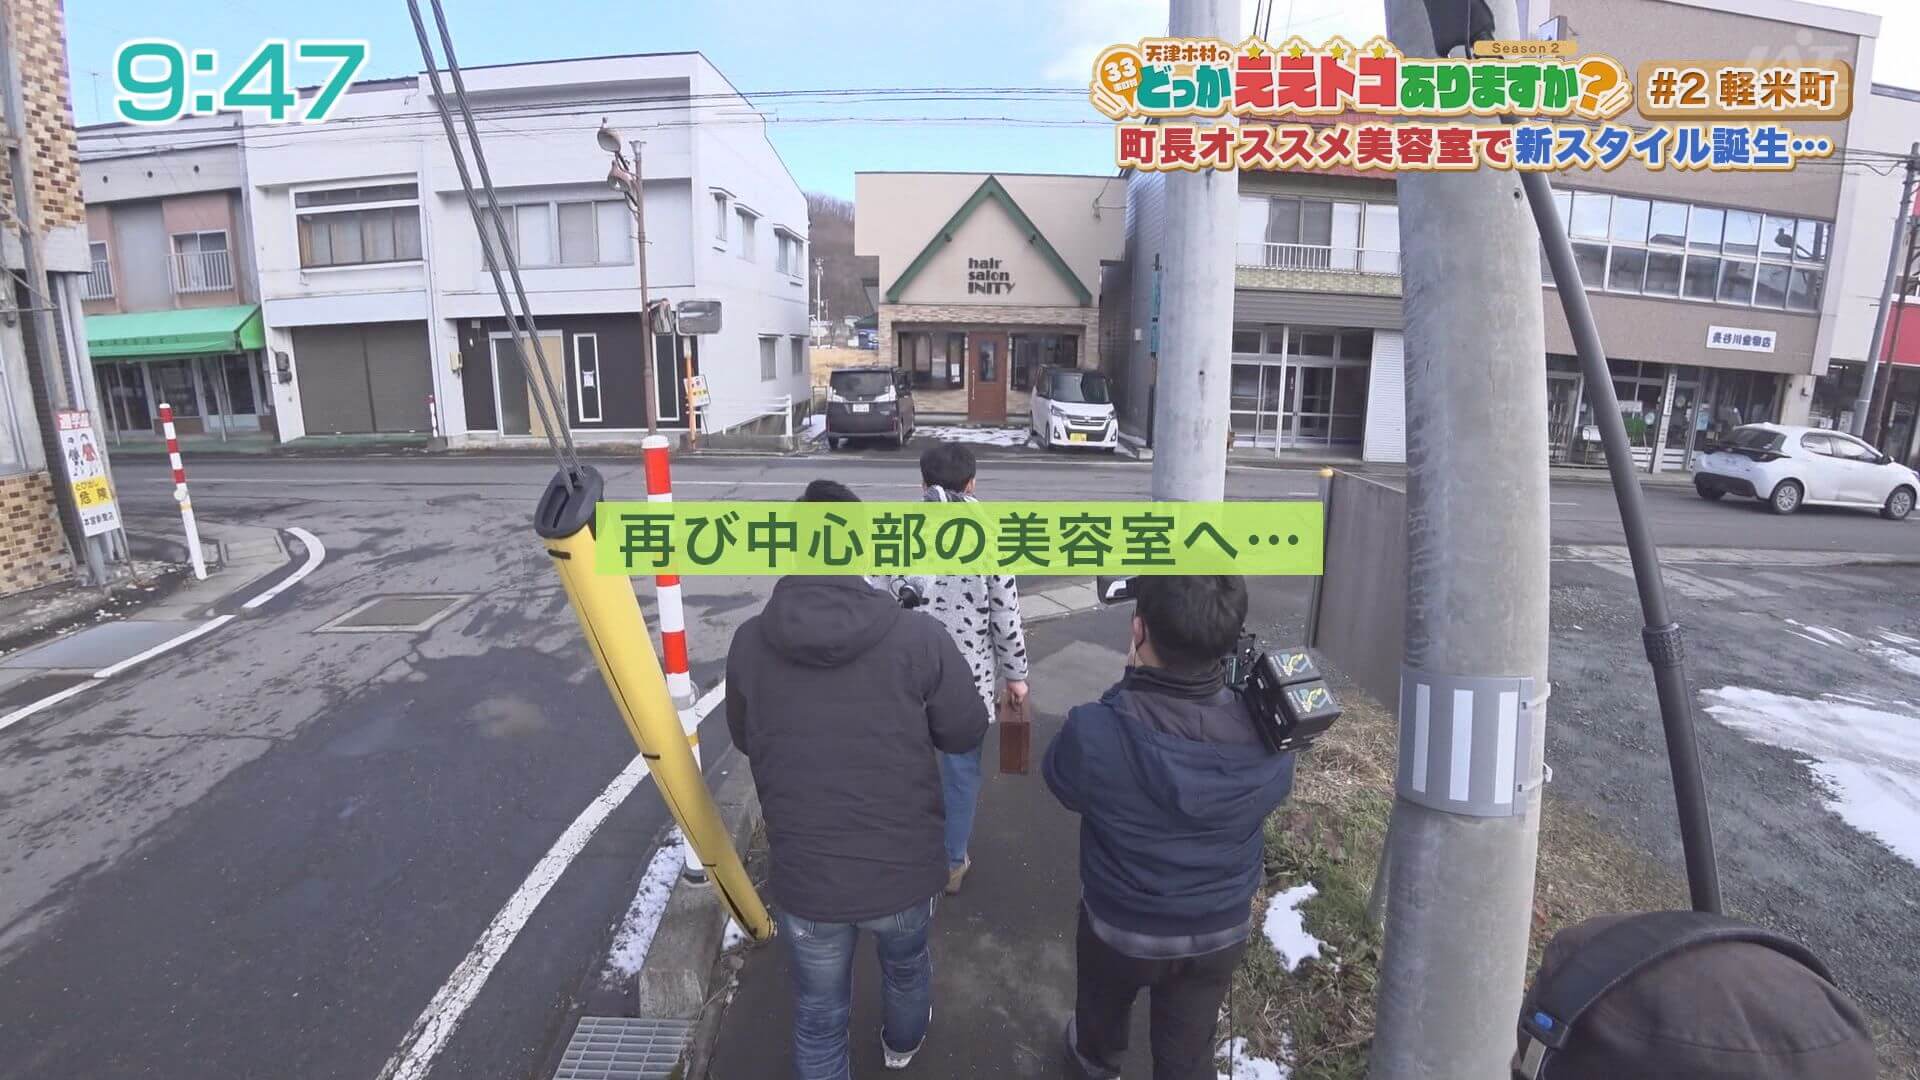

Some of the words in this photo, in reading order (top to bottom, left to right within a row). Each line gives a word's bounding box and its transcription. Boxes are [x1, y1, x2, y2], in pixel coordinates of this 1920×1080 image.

[968, 256, 1003, 270] hair
[968, 269, 1010, 281] salon
[968, 281, 1016, 295] INITY
